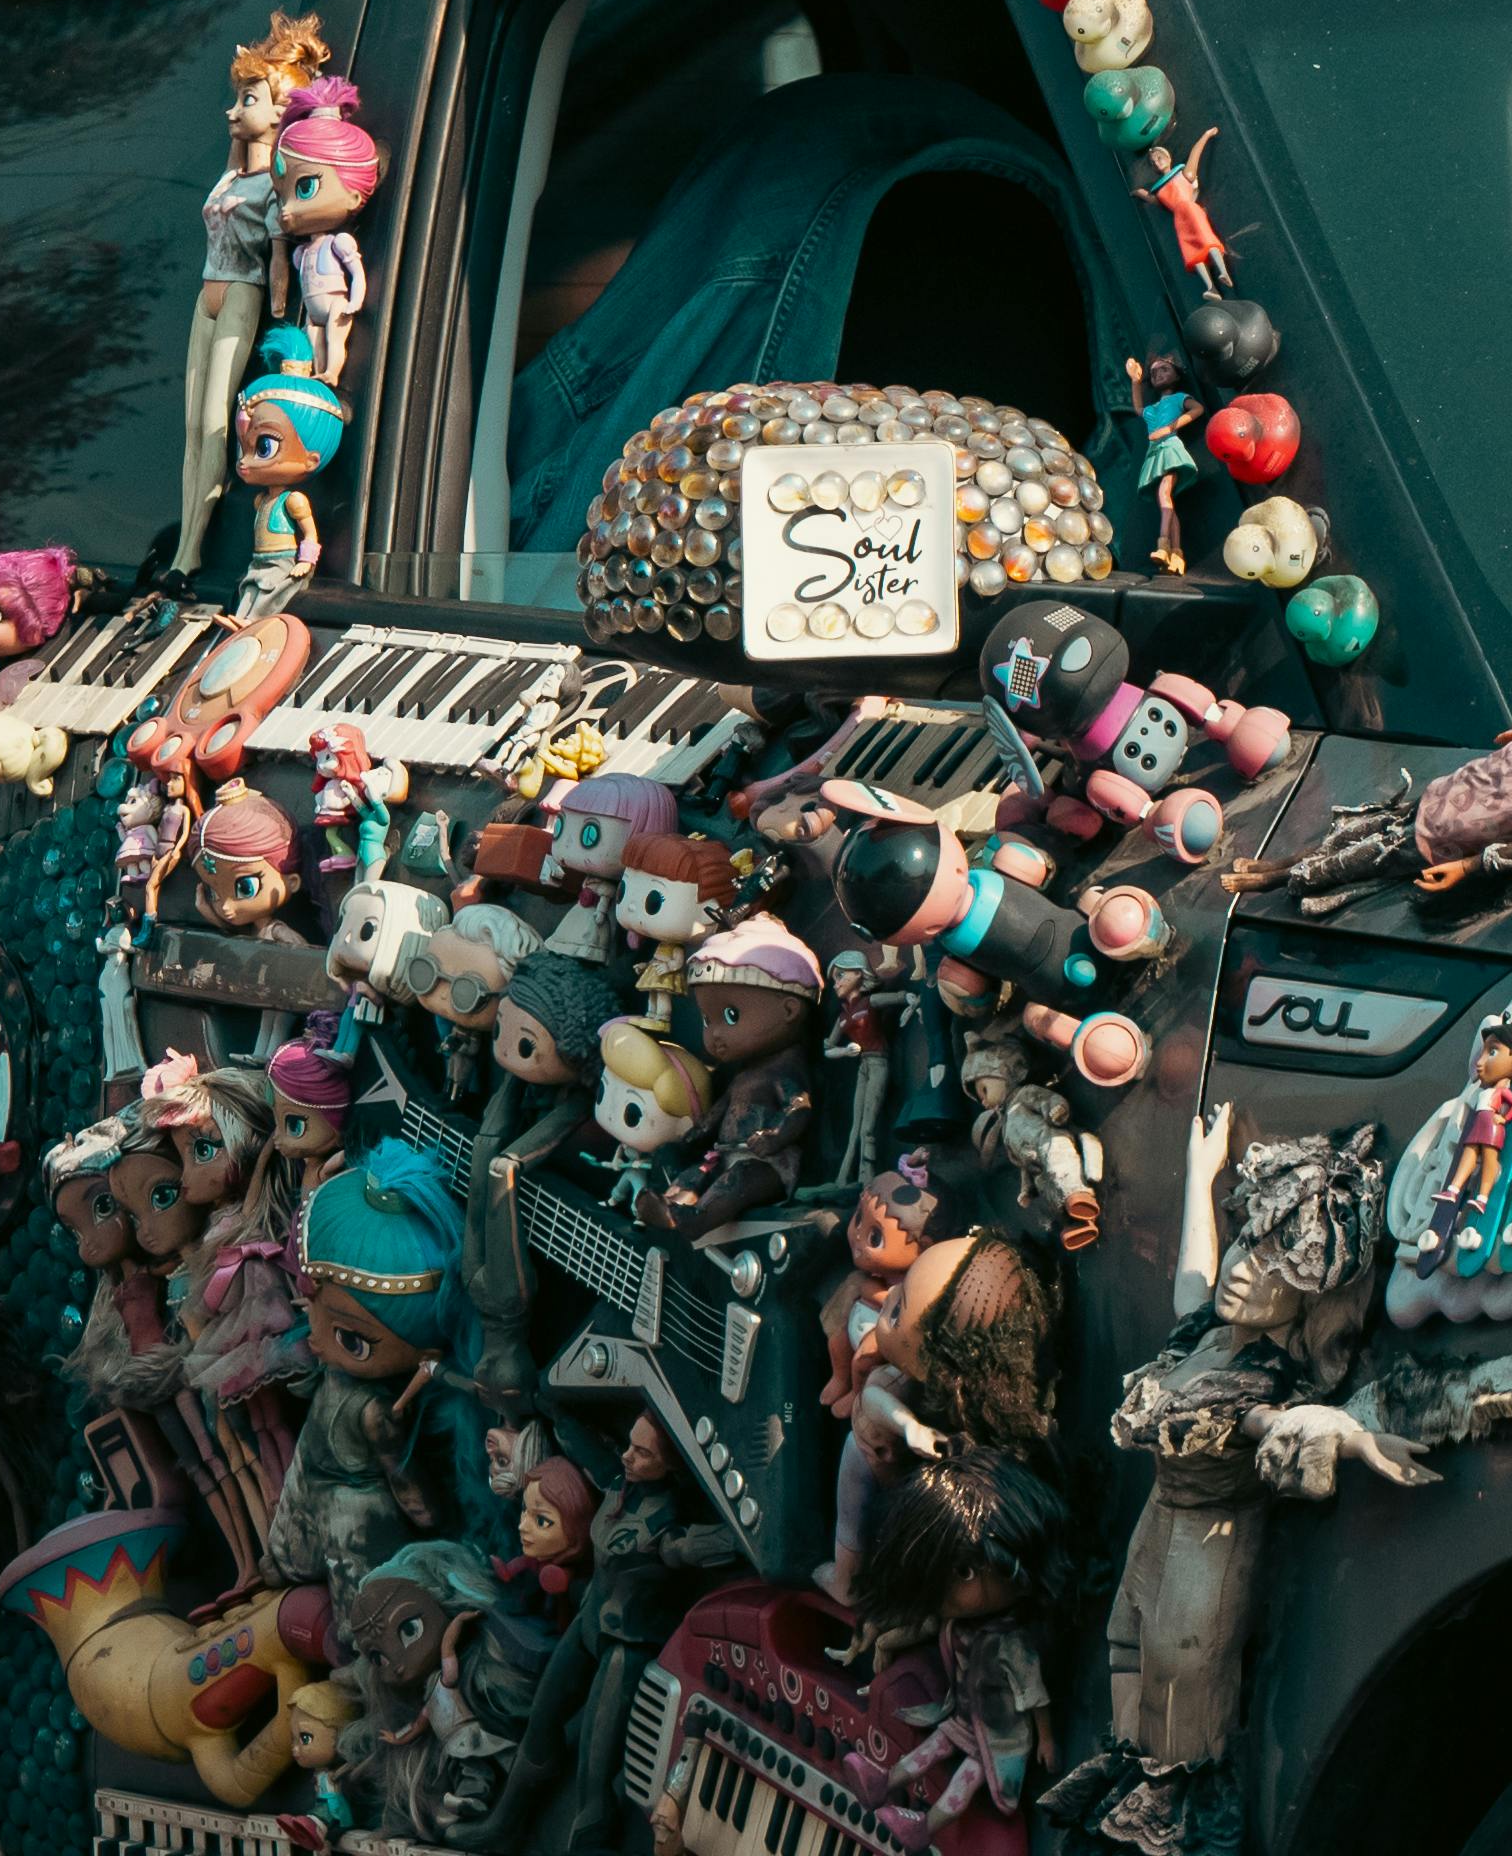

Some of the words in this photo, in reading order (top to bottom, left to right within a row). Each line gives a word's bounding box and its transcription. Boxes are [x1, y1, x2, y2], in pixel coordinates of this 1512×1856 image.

[782, 505, 923, 604] Soul
[1247, 994, 1370, 1040] SOUL
[785, 1402, 793, 1424] MIC
